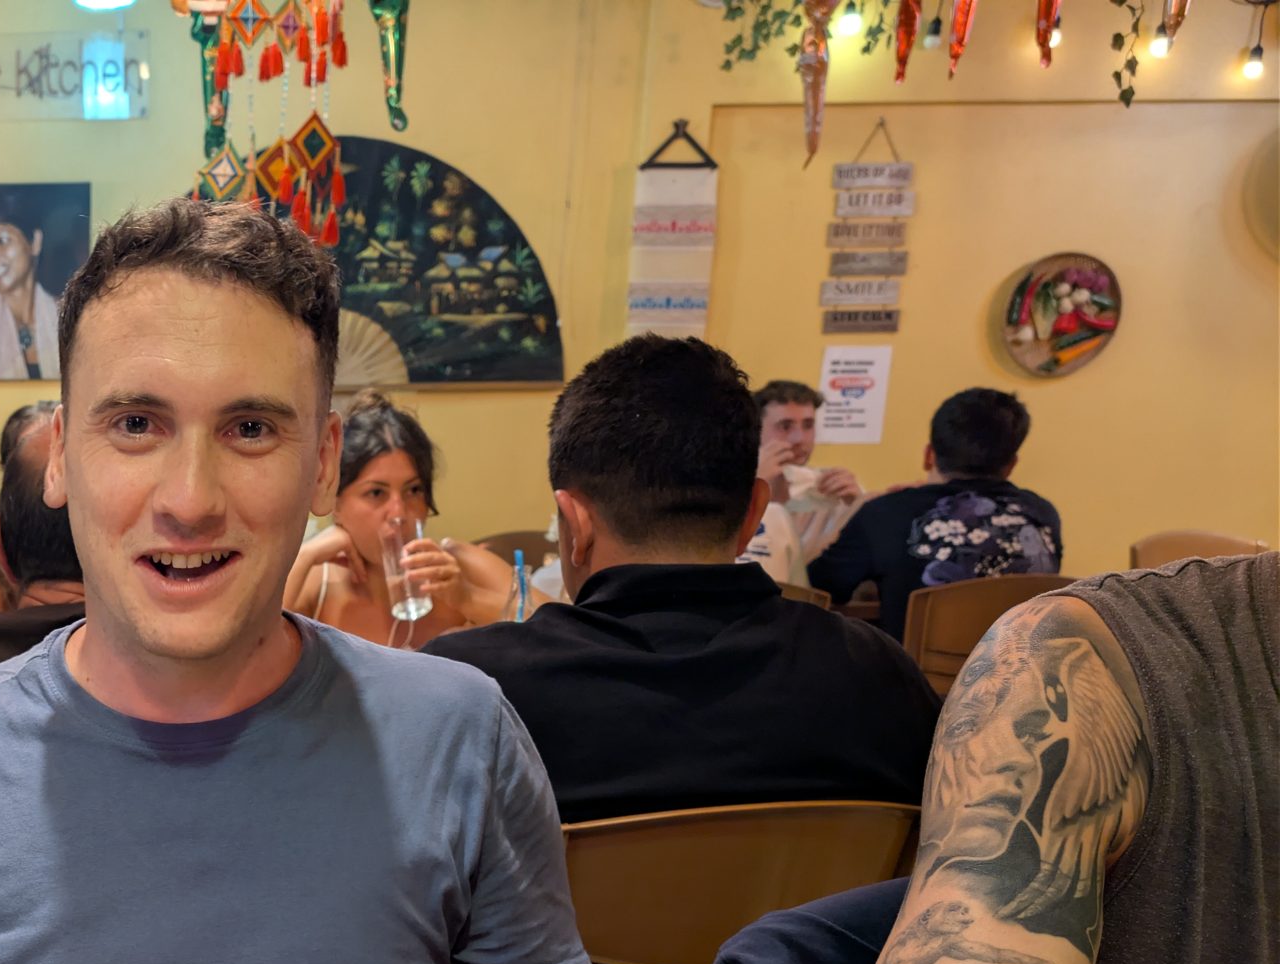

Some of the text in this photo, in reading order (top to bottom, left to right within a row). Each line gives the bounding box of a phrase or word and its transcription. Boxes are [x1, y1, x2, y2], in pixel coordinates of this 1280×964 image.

[848, 193, 869, 207] LET
[872, 193, 883, 206] IT
[834, 282, 886, 296] SMILE
